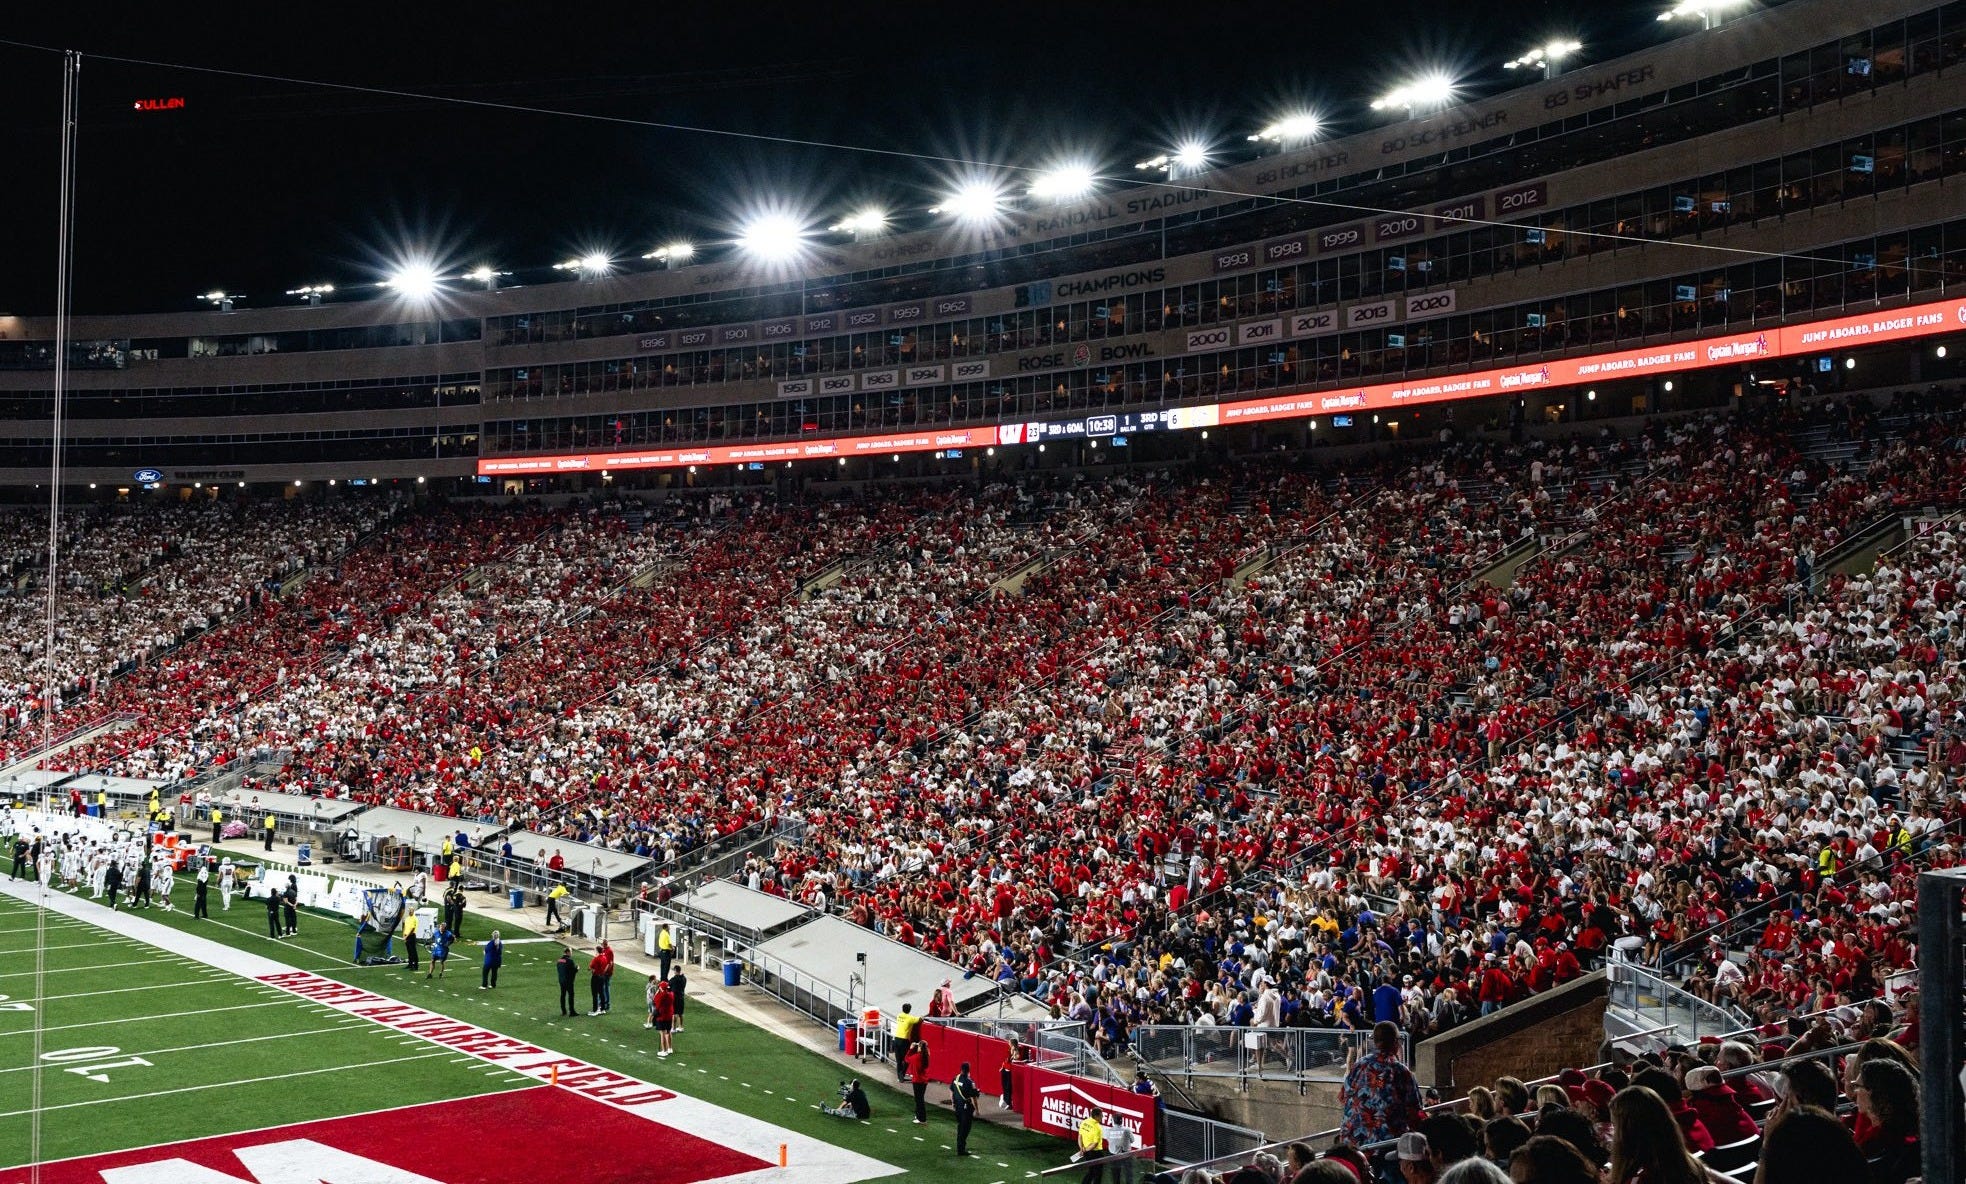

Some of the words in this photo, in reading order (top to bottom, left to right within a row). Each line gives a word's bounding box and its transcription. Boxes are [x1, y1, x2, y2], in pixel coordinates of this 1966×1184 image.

[1037, 206, 1119, 233] RANDALL
[1127, 186, 1209, 214] STADIUM
[1218, 252, 1248, 268] 1993
[1269, 242, 1302, 259] 1998
[1323, 230, 1358, 248] 1999
[1379, 218, 1417, 236] 2010
[1442, 204, 1474, 223] 2011
[1502, 189, 1538, 209] 2012
[1057, 268, 1165, 297] CHAMPIONS
[682, 333, 706, 345] 1897
[725, 329, 748, 340] 1901
[809, 319, 831, 331] 1912
[938, 301, 966, 313] 1962
[1190, 331, 1227, 347] 2000
[1246, 324, 1273, 339] 2011
[1297, 315, 1330, 331] 2012
[1354, 305, 1388, 322] 2013
[1410, 295, 1450, 313] 2020
[1801, 332, 1828, 344] JUMP
[1829, 325, 1872, 340] ABOARD,
[1873, 318, 1913, 333] BADGER
[1916, 313, 1944, 327] FANS
[1018, 353, 1064, 371] ROSE
[1101, 343, 1155, 361] BOWL
[1578, 364, 1600, 376] JUMP
[1637, 354, 1671, 367] BADGER
[1673, 351, 1696, 362] FANS
[1707, 345, 1733, 360] Captain
[1731, 341, 1758, 357] Morgan
[911, 370, 938, 381] 1994
[957, 365, 984, 376] 1999
[1392, 390, 1411, 399] JUMP
[1473, 379, 1491, 389] FANS
[1066, 422, 1085, 433] GOAL
[1089, 419, 1114, 432] 10:38
[1124, 415, 1130, 426] 1
[1140, 412, 1158, 424] 3RD
[1028, 427, 1038, 438] 23
[254, 971, 387, 1005] BARRY
[352, 1005, 546, 1060] ALVAREZ
[514, 1058, 678, 1106] FIELD
[40, 1046, 154, 1076] 10
[1042, 1095, 1096, 1121] AMERICA
[1101, 1111, 1142, 1134] FAILY
